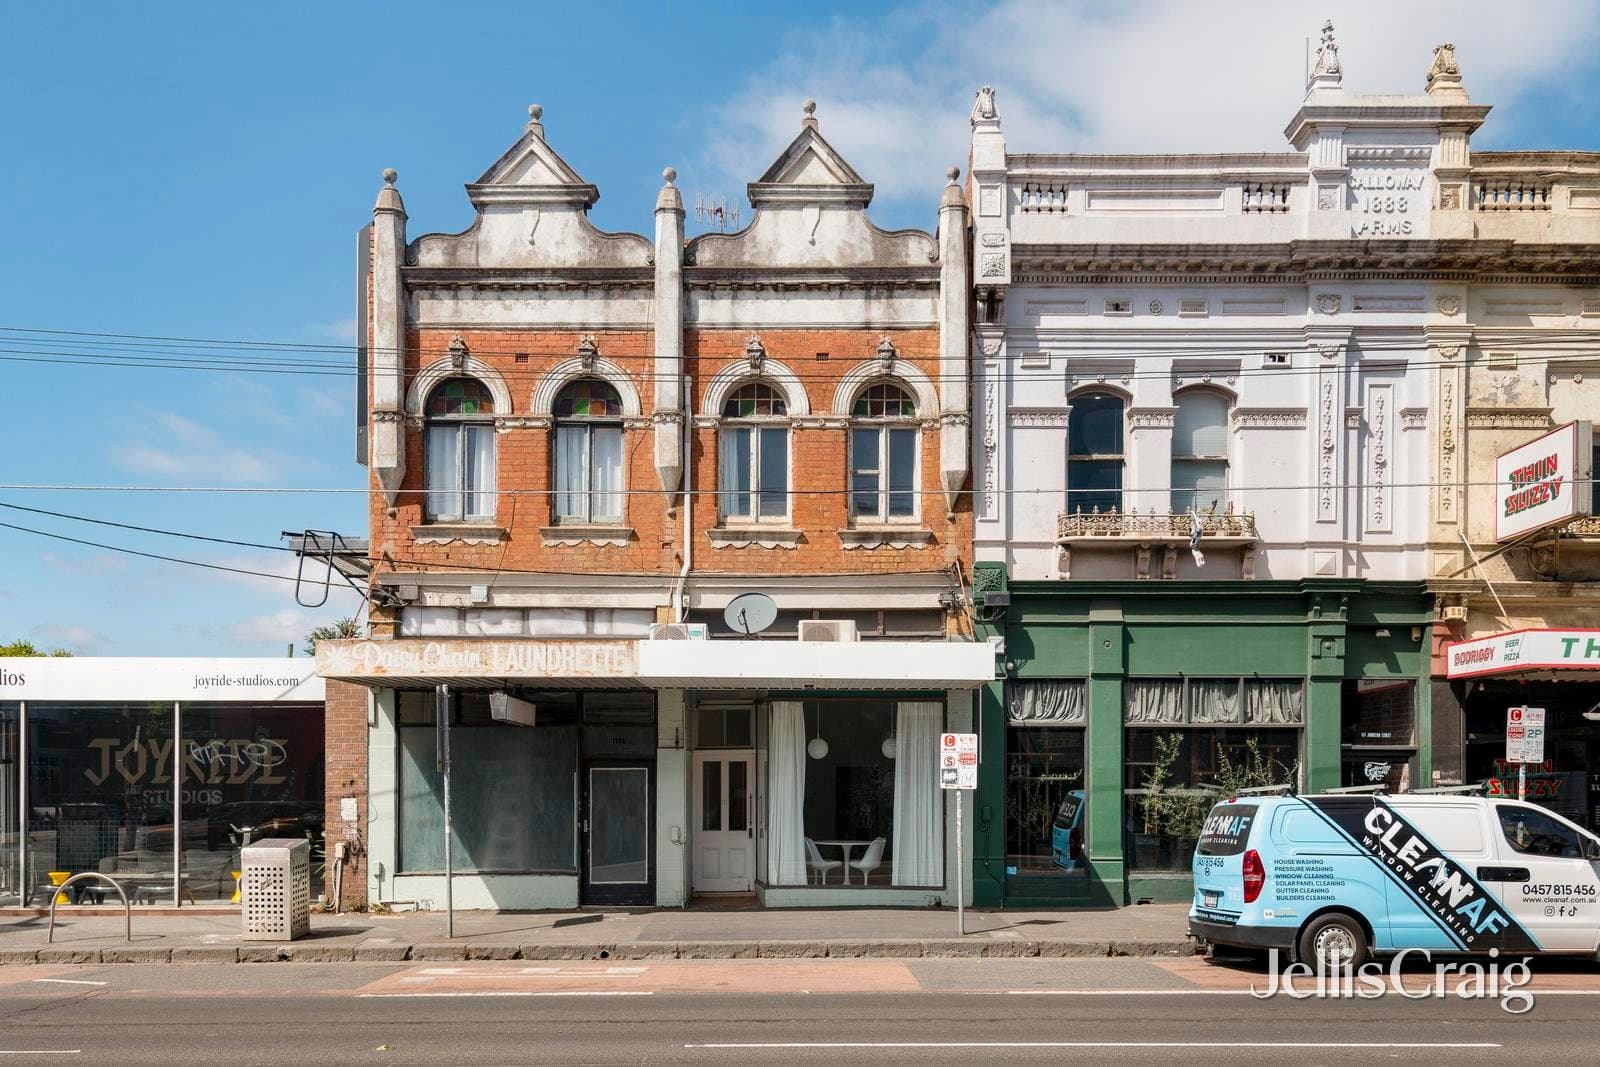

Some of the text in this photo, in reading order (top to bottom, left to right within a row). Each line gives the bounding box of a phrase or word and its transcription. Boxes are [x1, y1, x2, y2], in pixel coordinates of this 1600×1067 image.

[1348, 175, 1424, 191] GALLOWAY
[1363, 196, 1408, 214] 1888
[1357, 221, 1412, 236] ARMS
[1509, 453, 1558, 491] THIN
[1504, 475, 1564, 518] SLIZZY
[1505, 639, 1520, 649] BEER
[493, 644, 625, 672] LAUNDRETTE
[1454, 646, 1495, 667] BODRIGGY
[1504, 652, 1520, 662] PIZZA
[0, 668, 25, 685] ios
[193, 673, 300, 692] joyride-studios.com
[1527, 729, 1542, 739] 2P
[84, 738, 288, 787] JOYRIDE
[142, 789, 223, 805] STUDIOS
[1362, 836, 1475, 944] WINDOW CLEANING
[1522, 884, 1596, 896] 0457 815 456
[1522, 896, 1597, 904] www.cleanaf.com.au
